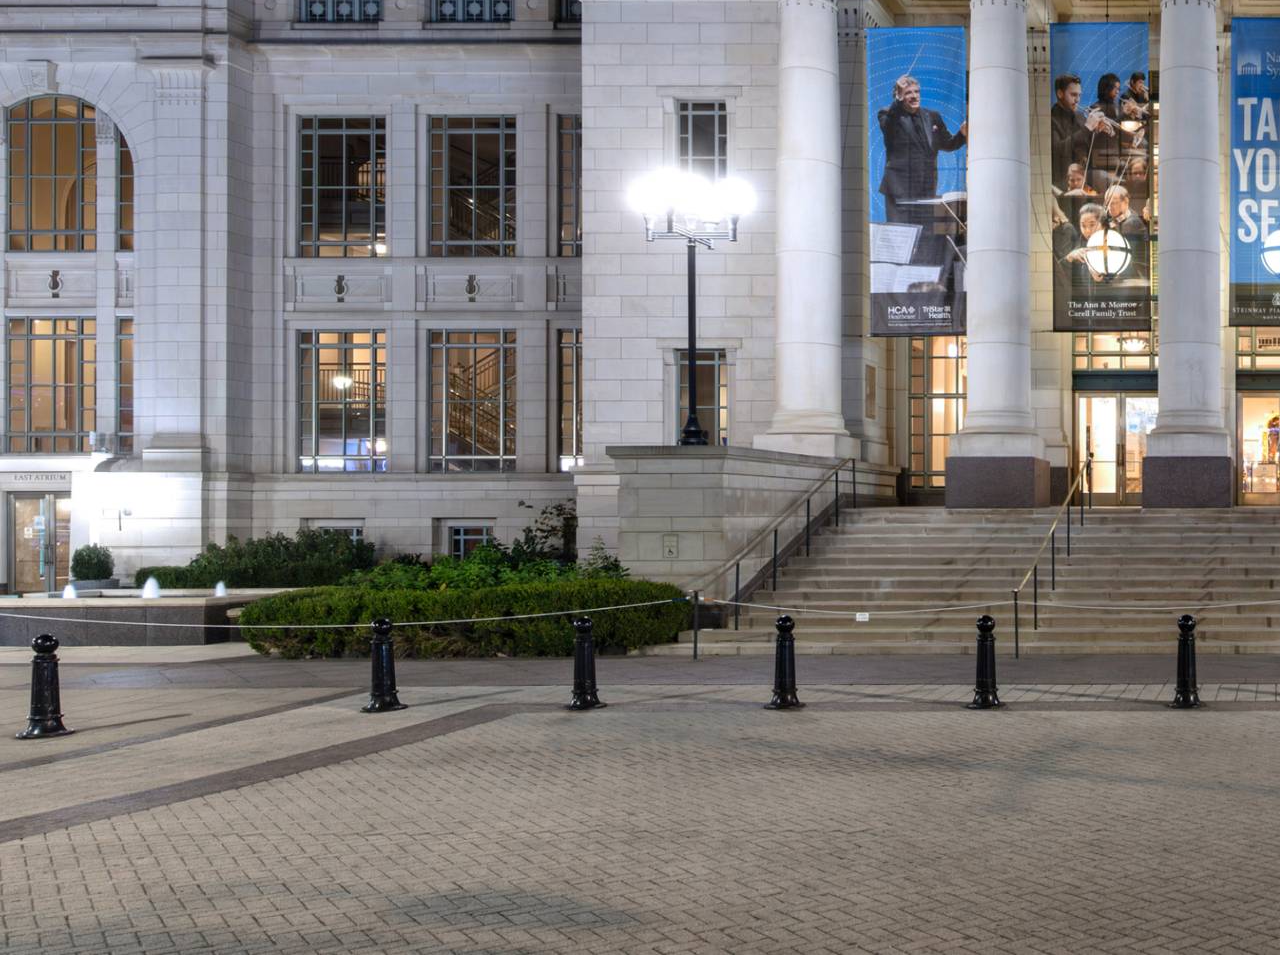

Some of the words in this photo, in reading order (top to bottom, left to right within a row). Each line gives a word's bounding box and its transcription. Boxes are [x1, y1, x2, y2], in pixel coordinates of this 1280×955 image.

[887, 306, 908, 314] HCA
[1091, 309, 1117, 318] Family
[1118, 309, 1137, 317] Trust
